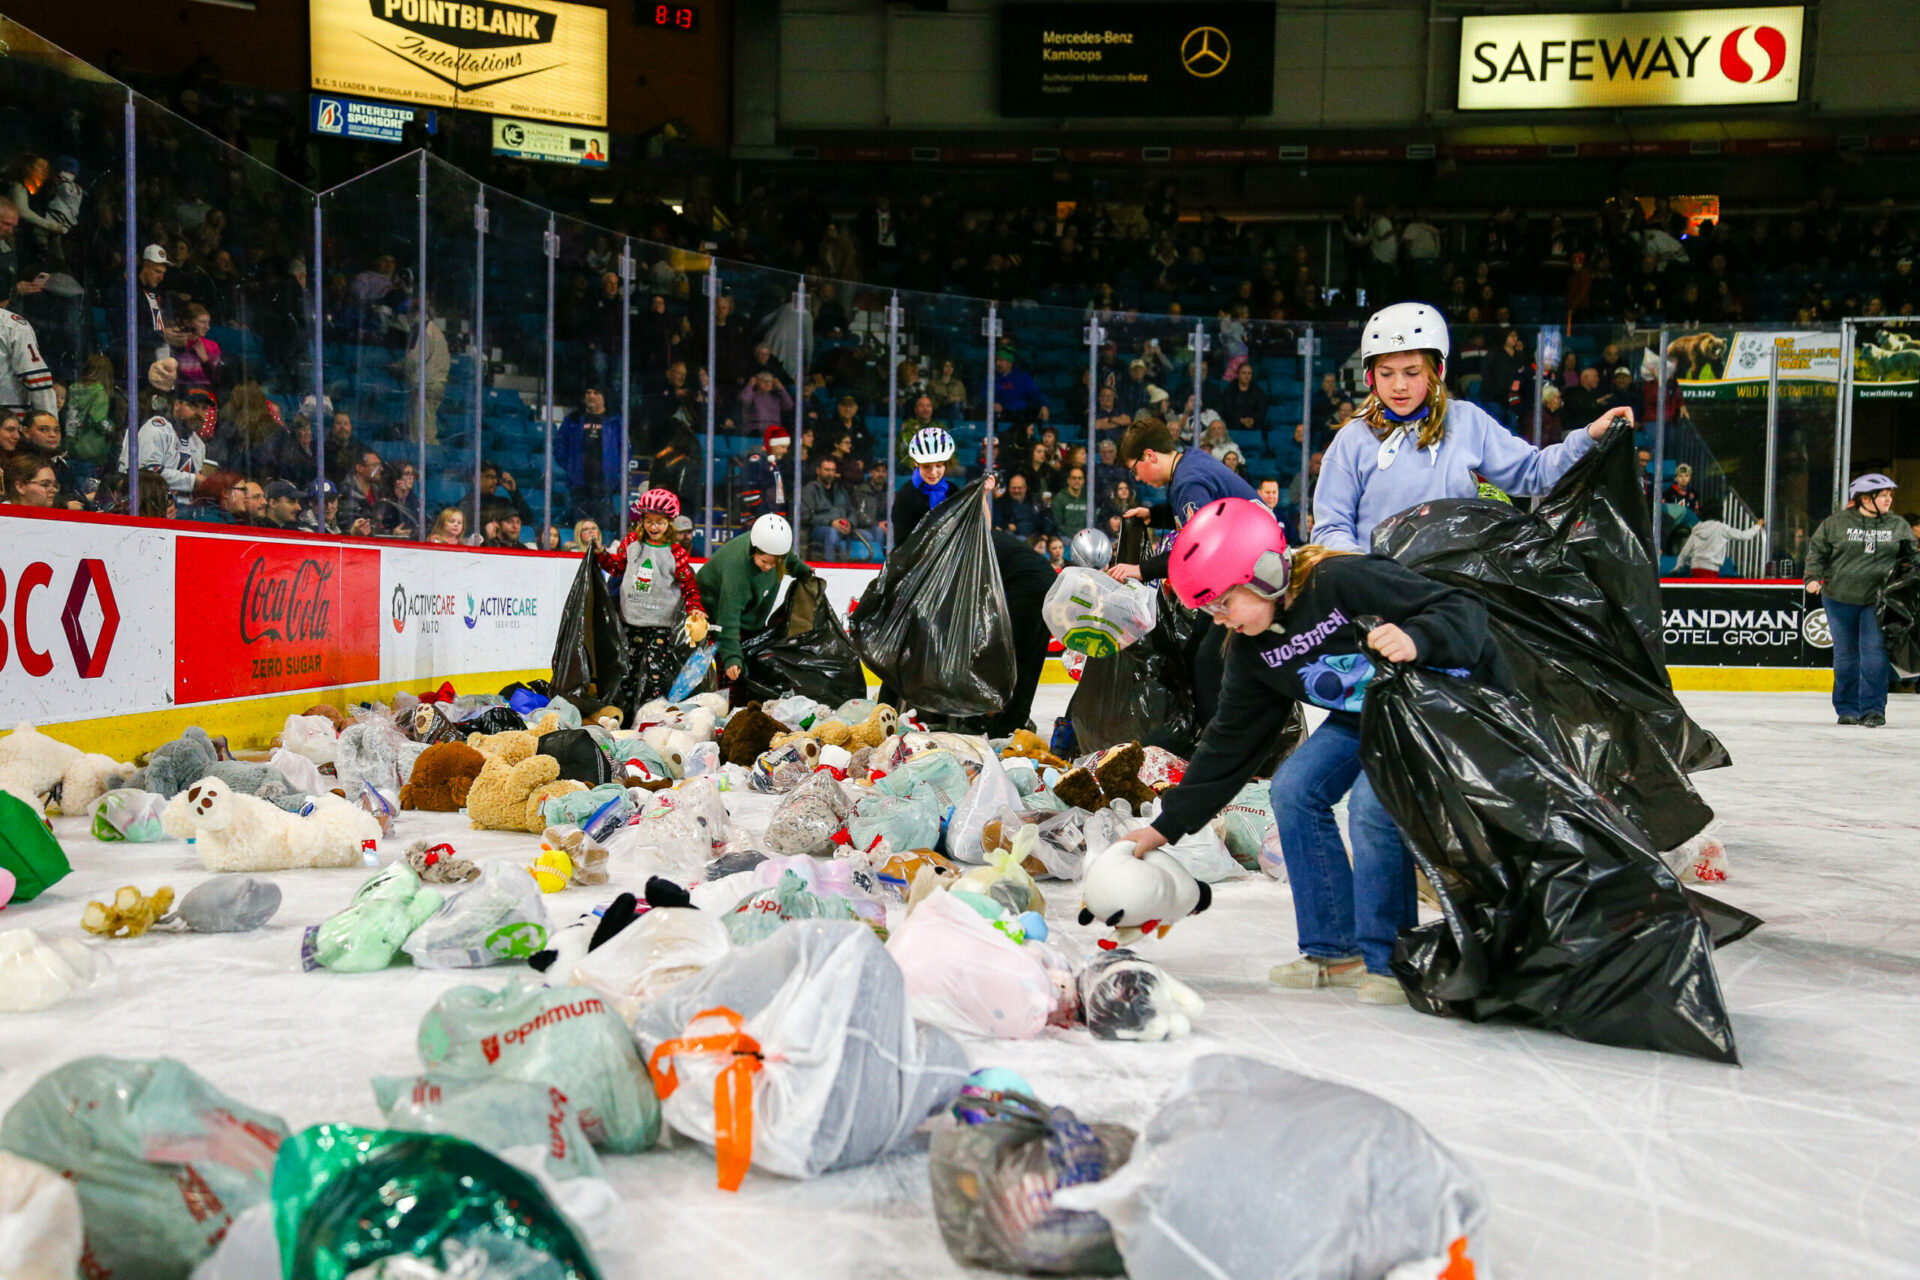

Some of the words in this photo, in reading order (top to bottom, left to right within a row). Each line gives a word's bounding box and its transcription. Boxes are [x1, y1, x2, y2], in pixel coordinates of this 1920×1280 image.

[385, 0, 541, 40] POINTBLANK
[656, 4, 692, 29] 8:13
[1043, 31, 1134, 44] Mercedes-Benz
[396, 36, 522, 72] Installations
[1043, 49, 1102, 63] Kamloops
[1472, 36, 1712, 83] SAFEWAY
[1043, 73, 1086, 82] Authorized
[1087, 73, 1148, 82] Mercedes-Benz
[339, 81, 367, 91] LEADER
[378, 86, 412, 97] MODULAR
[414, 91, 447, 102] BUILDING
[348, 103, 414, 121] INTERESTED
[1775, 337, 1794, 349] BC
[1777, 359, 1811, 369] PARK
[1737, 385, 1759, 398] WILD
[408, 594, 455, 616] ACTIVECARE
[480, 597, 537, 616] ACTIVECARE
[0, 561, 54, 677] C
[421, 621, 439, 633] AUTO
[495, 620, 520, 628] SERVICES
[1662, 629, 1719, 645] OTEL
[1723, 630, 1798, 646] GROUP
[252, 658, 283, 679] ZERO
[286, 654, 322, 675] SUGAR
[504, 998, 606, 1044] optimum
